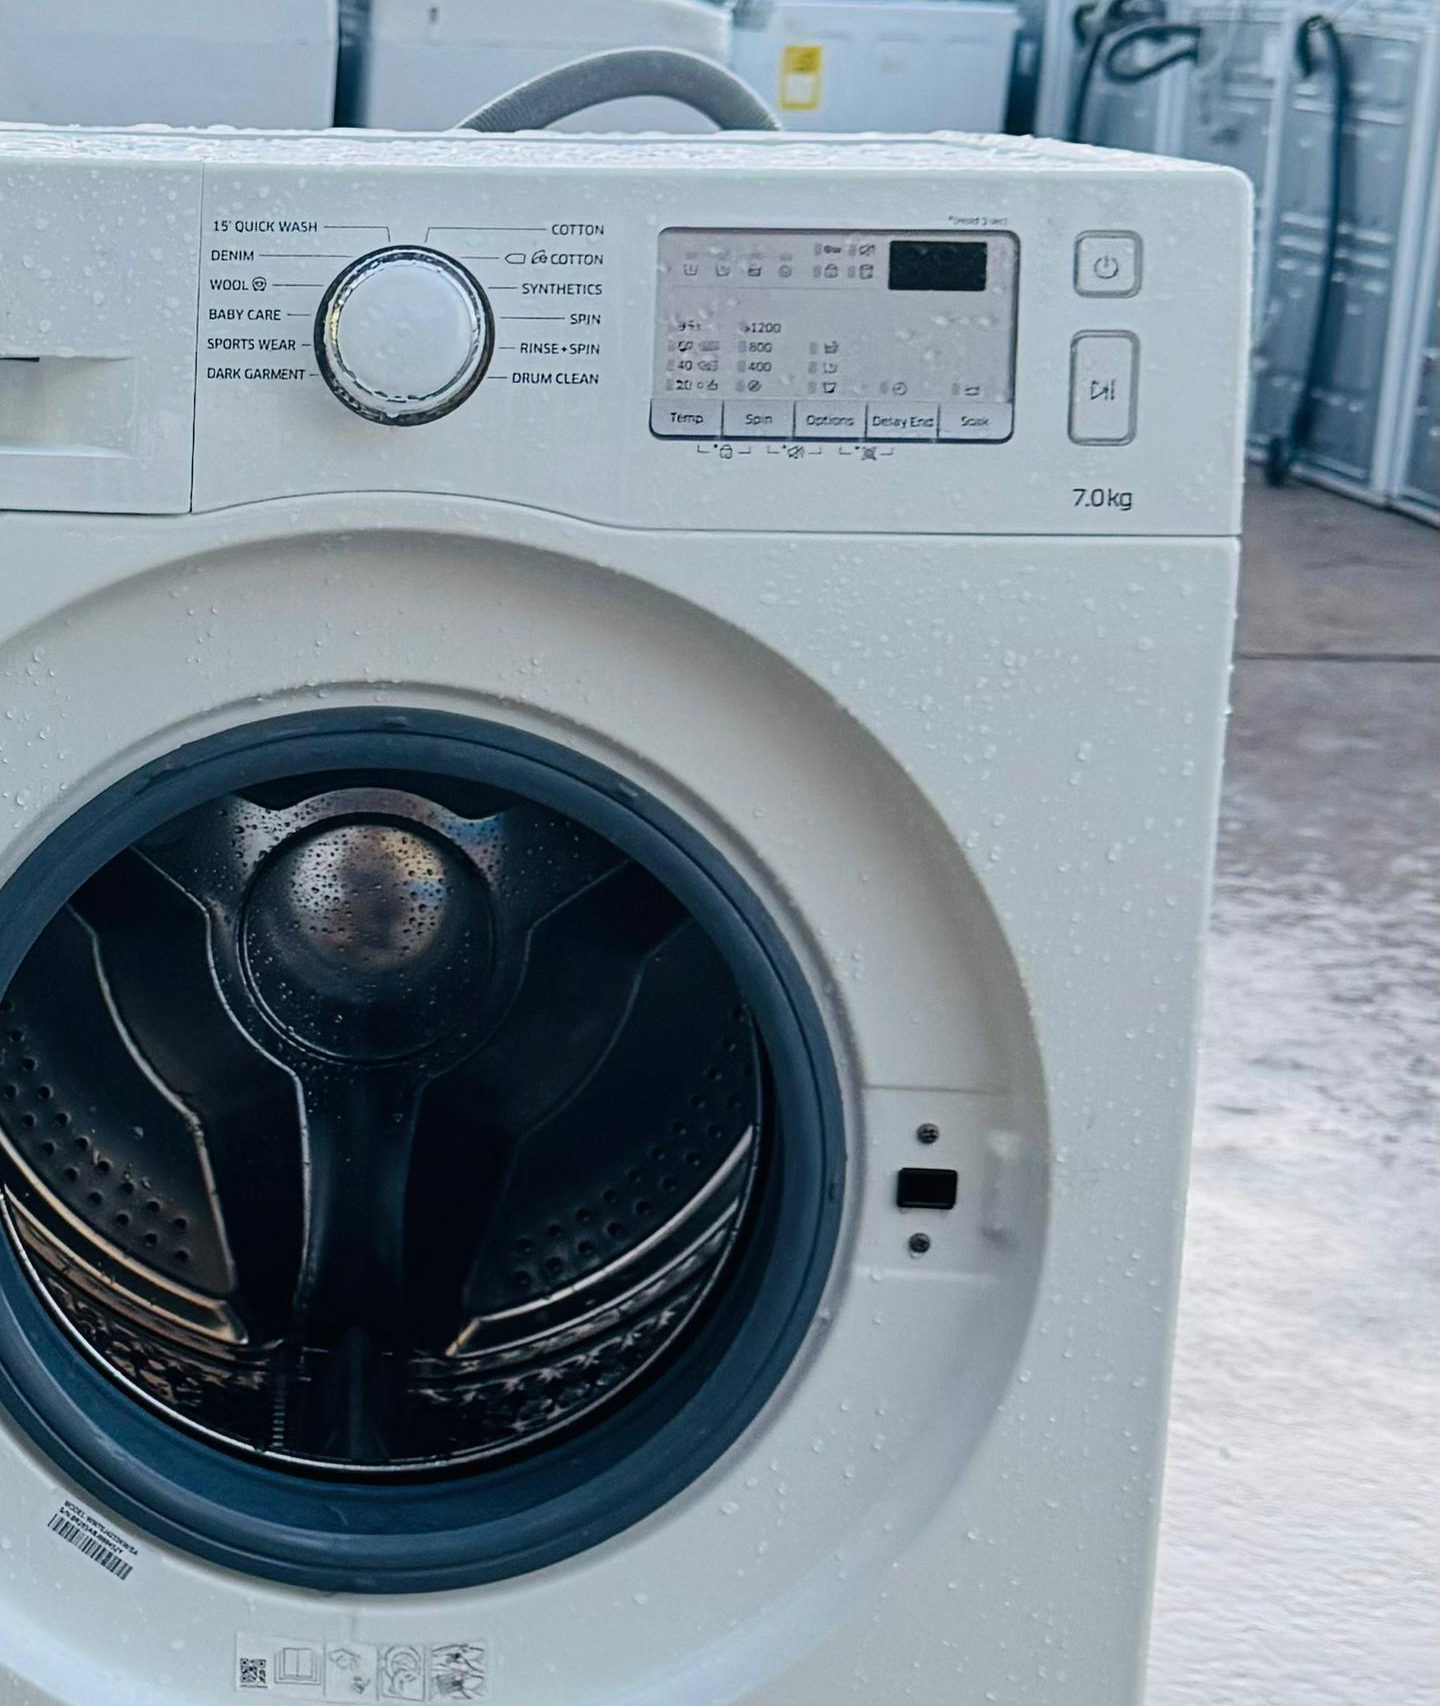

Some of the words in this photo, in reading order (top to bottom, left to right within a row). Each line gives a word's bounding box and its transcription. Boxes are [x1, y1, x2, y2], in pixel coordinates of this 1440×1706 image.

[234, 220, 275, 233] QUICK
[278, 221, 318, 233] WASH
[551, 224, 605, 236] COTTON
[211, 250, 255, 262] DENIM
[550, 253, 604, 265] COTTON
[210, 279, 249, 291] WOOL
[521, 282, 603, 296] SYNTHETICS
[208, 309, 245, 321] BABY
[248, 309, 282, 321] CARE
[570, 313, 601, 325] SPIN
[207, 338, 256, 351] SPORTS
[258, 339, 296, 351] WEAR
[748, 342, 773, 353] 800
[748, 362, 772, 372] 400
[207, 368, 241, 380] DARK
[244, 368, 305, 381] GARMENT
[512, 372, 552, 385] DRUM
[555, 373, 600, 385] CLEAN
[670, 413, 704, 425] Temp
[745, 414, 772, 426] Spin
[806, 414, 855, 427] Options
[872, 416, 908, 429] Delay
[961, 416, 990, 427] Soak
[1072, 488, 1133, 511] 7.0kg
